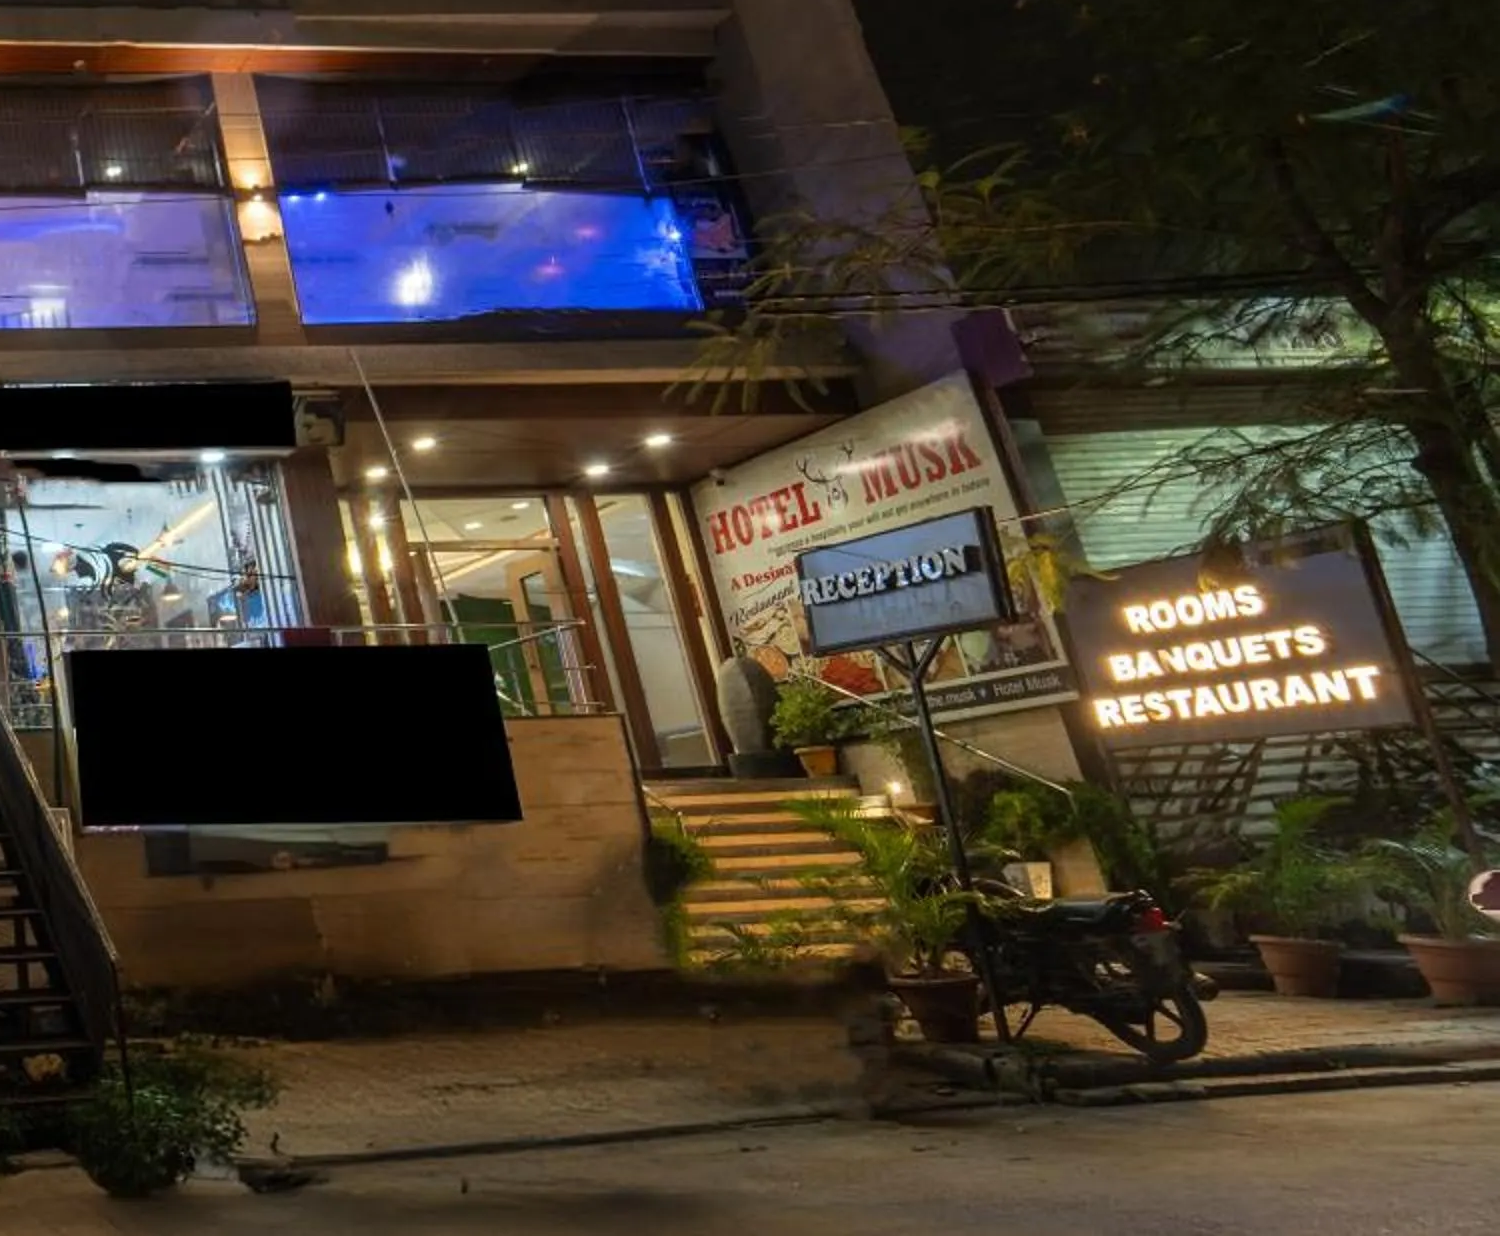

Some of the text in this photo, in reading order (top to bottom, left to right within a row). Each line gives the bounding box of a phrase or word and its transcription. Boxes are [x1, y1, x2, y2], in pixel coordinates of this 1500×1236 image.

[708, 426, 982, 555] HOTEL MUSK
[800, 544, 967, 605] RECEPTION
[1124, 586, 1265, 633] ROOMS
[1108, 626, 1327, 682] BANQUETS
[1093, 666, 1381, 729] RESTAURANT
